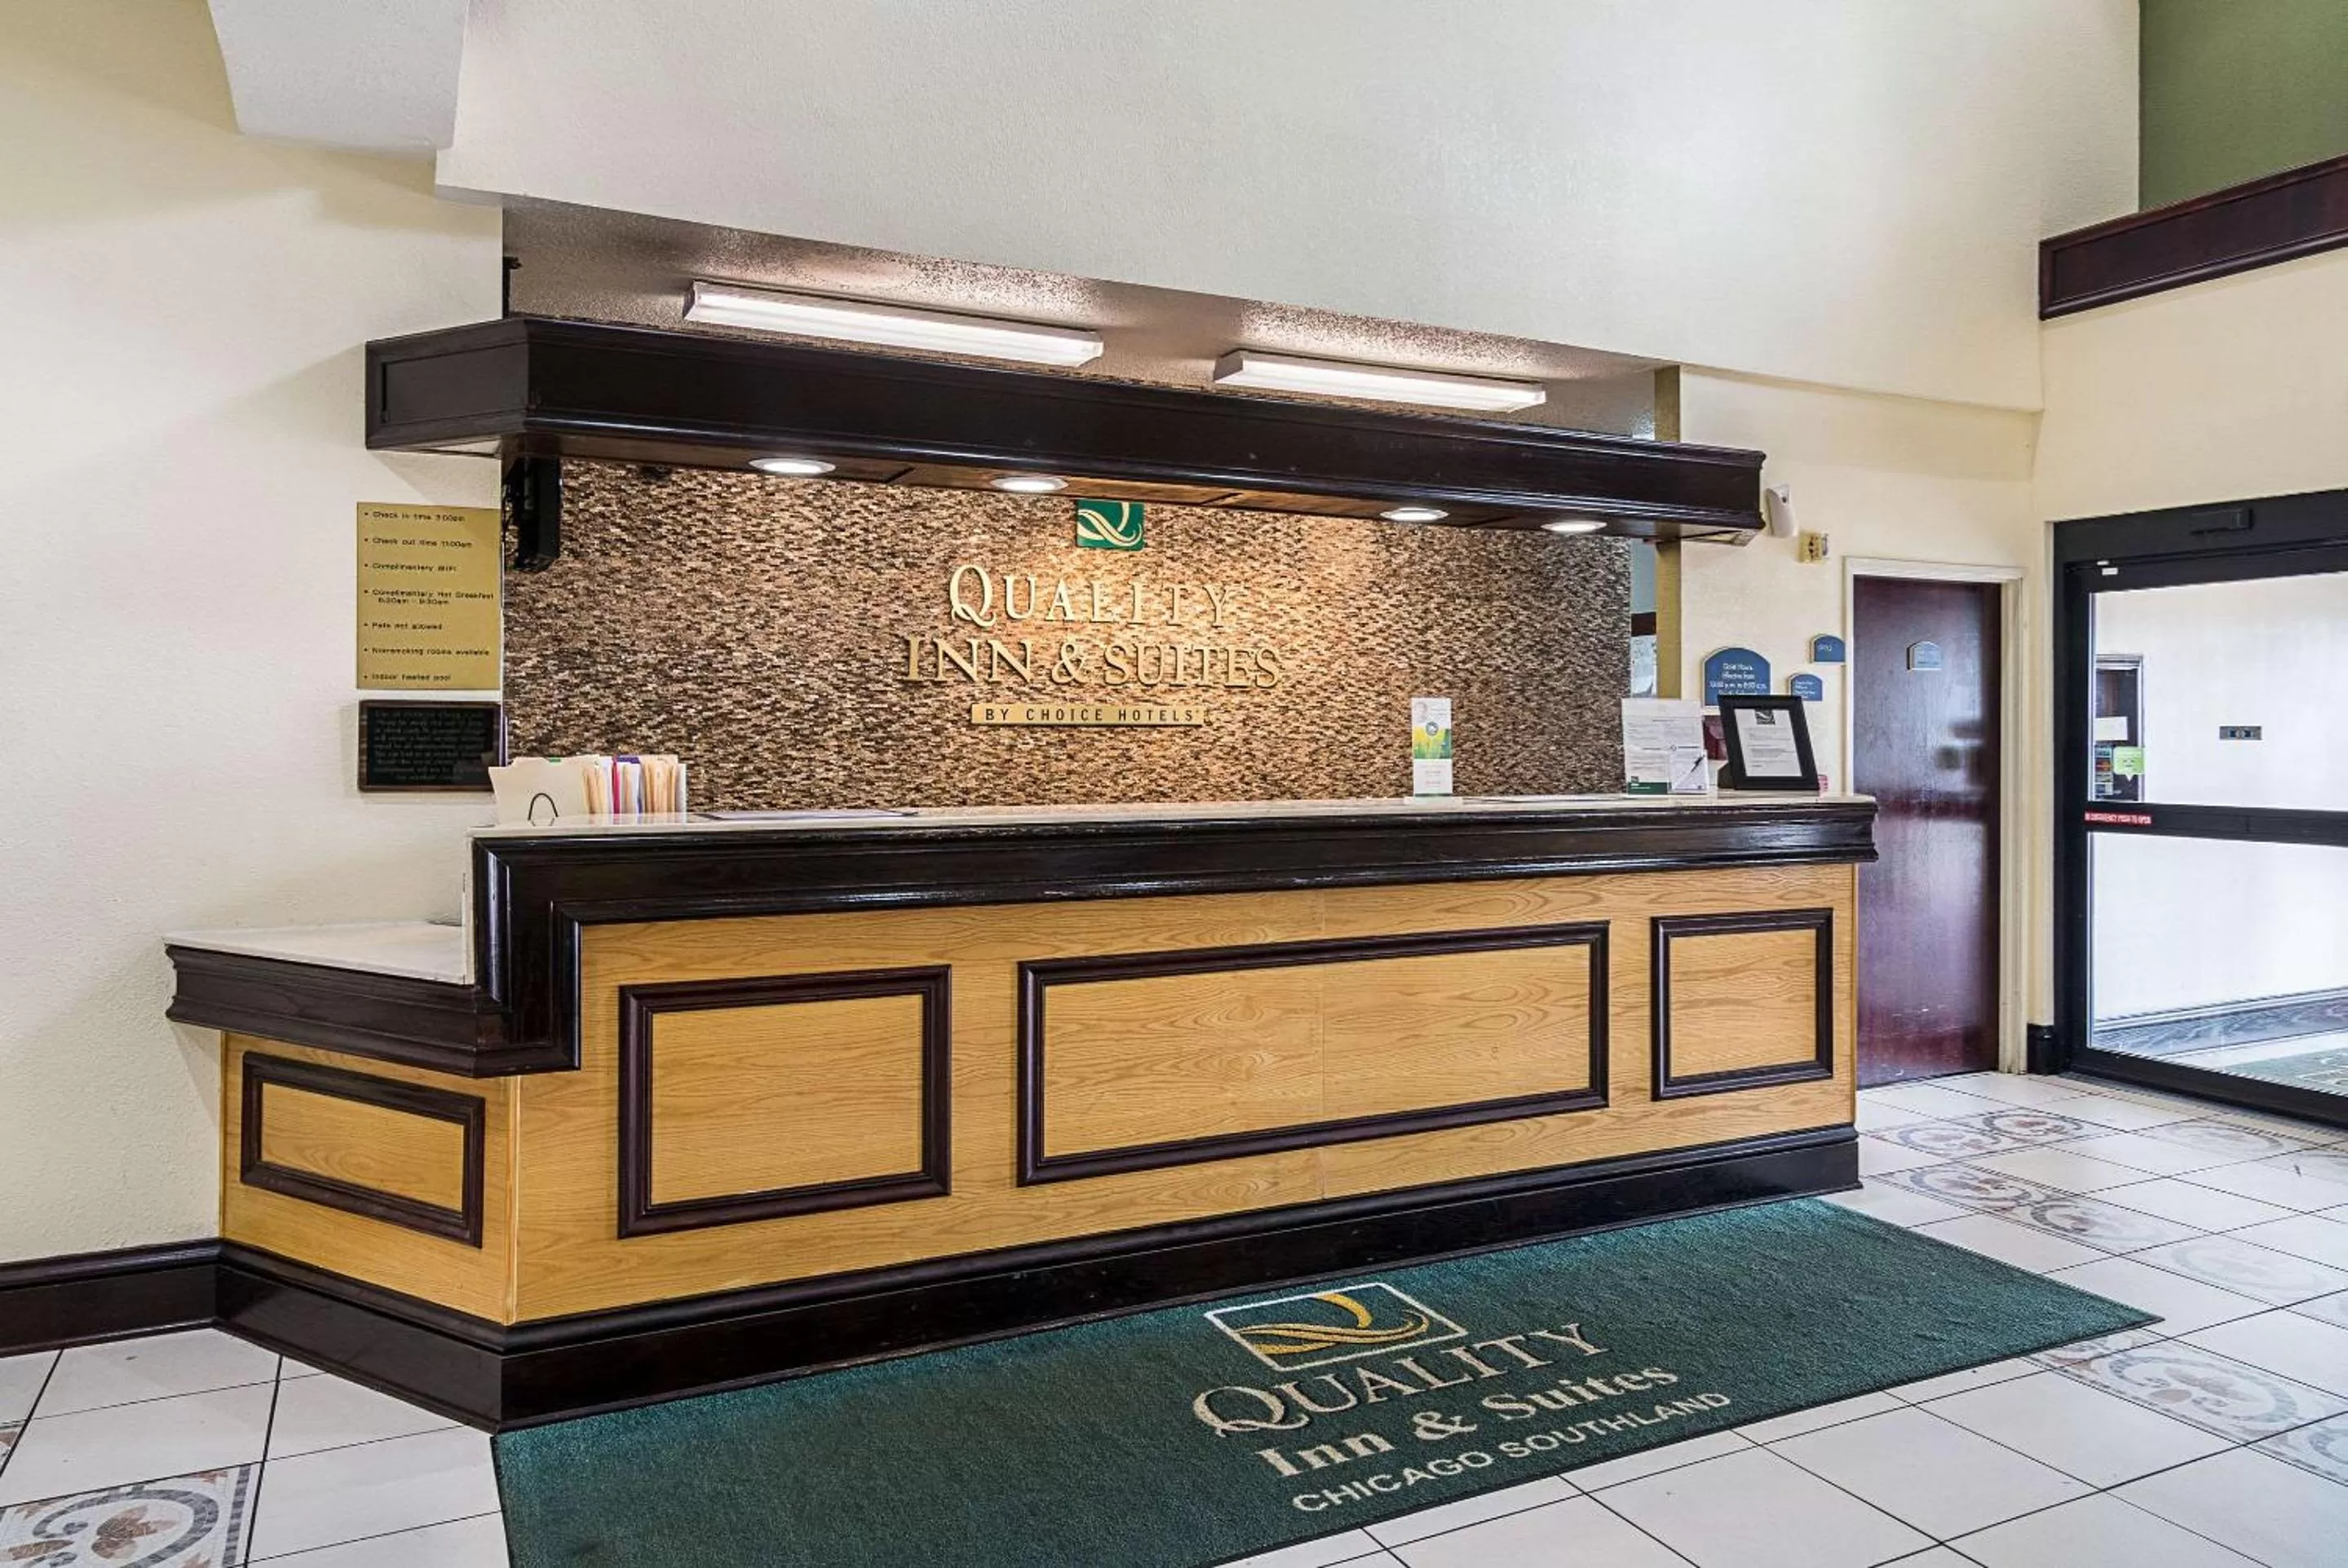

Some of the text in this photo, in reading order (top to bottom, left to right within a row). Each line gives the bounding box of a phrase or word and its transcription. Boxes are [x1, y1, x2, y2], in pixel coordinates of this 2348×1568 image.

[372, 537, 398, 545] Check
[949, 564, 1233, 628] QUALITY
[904, 634, 1281, 689] INN & SUITES
[985, 708, 1194, 722] BY CHOICE HOTELS
[1193, 1323, 1608, 1438] QUALITY
[1256, 1367, 1678, 1477] Inn & Suites
[1292, 1393, 1731, 1512] CHICAGO SOUTHLAND
